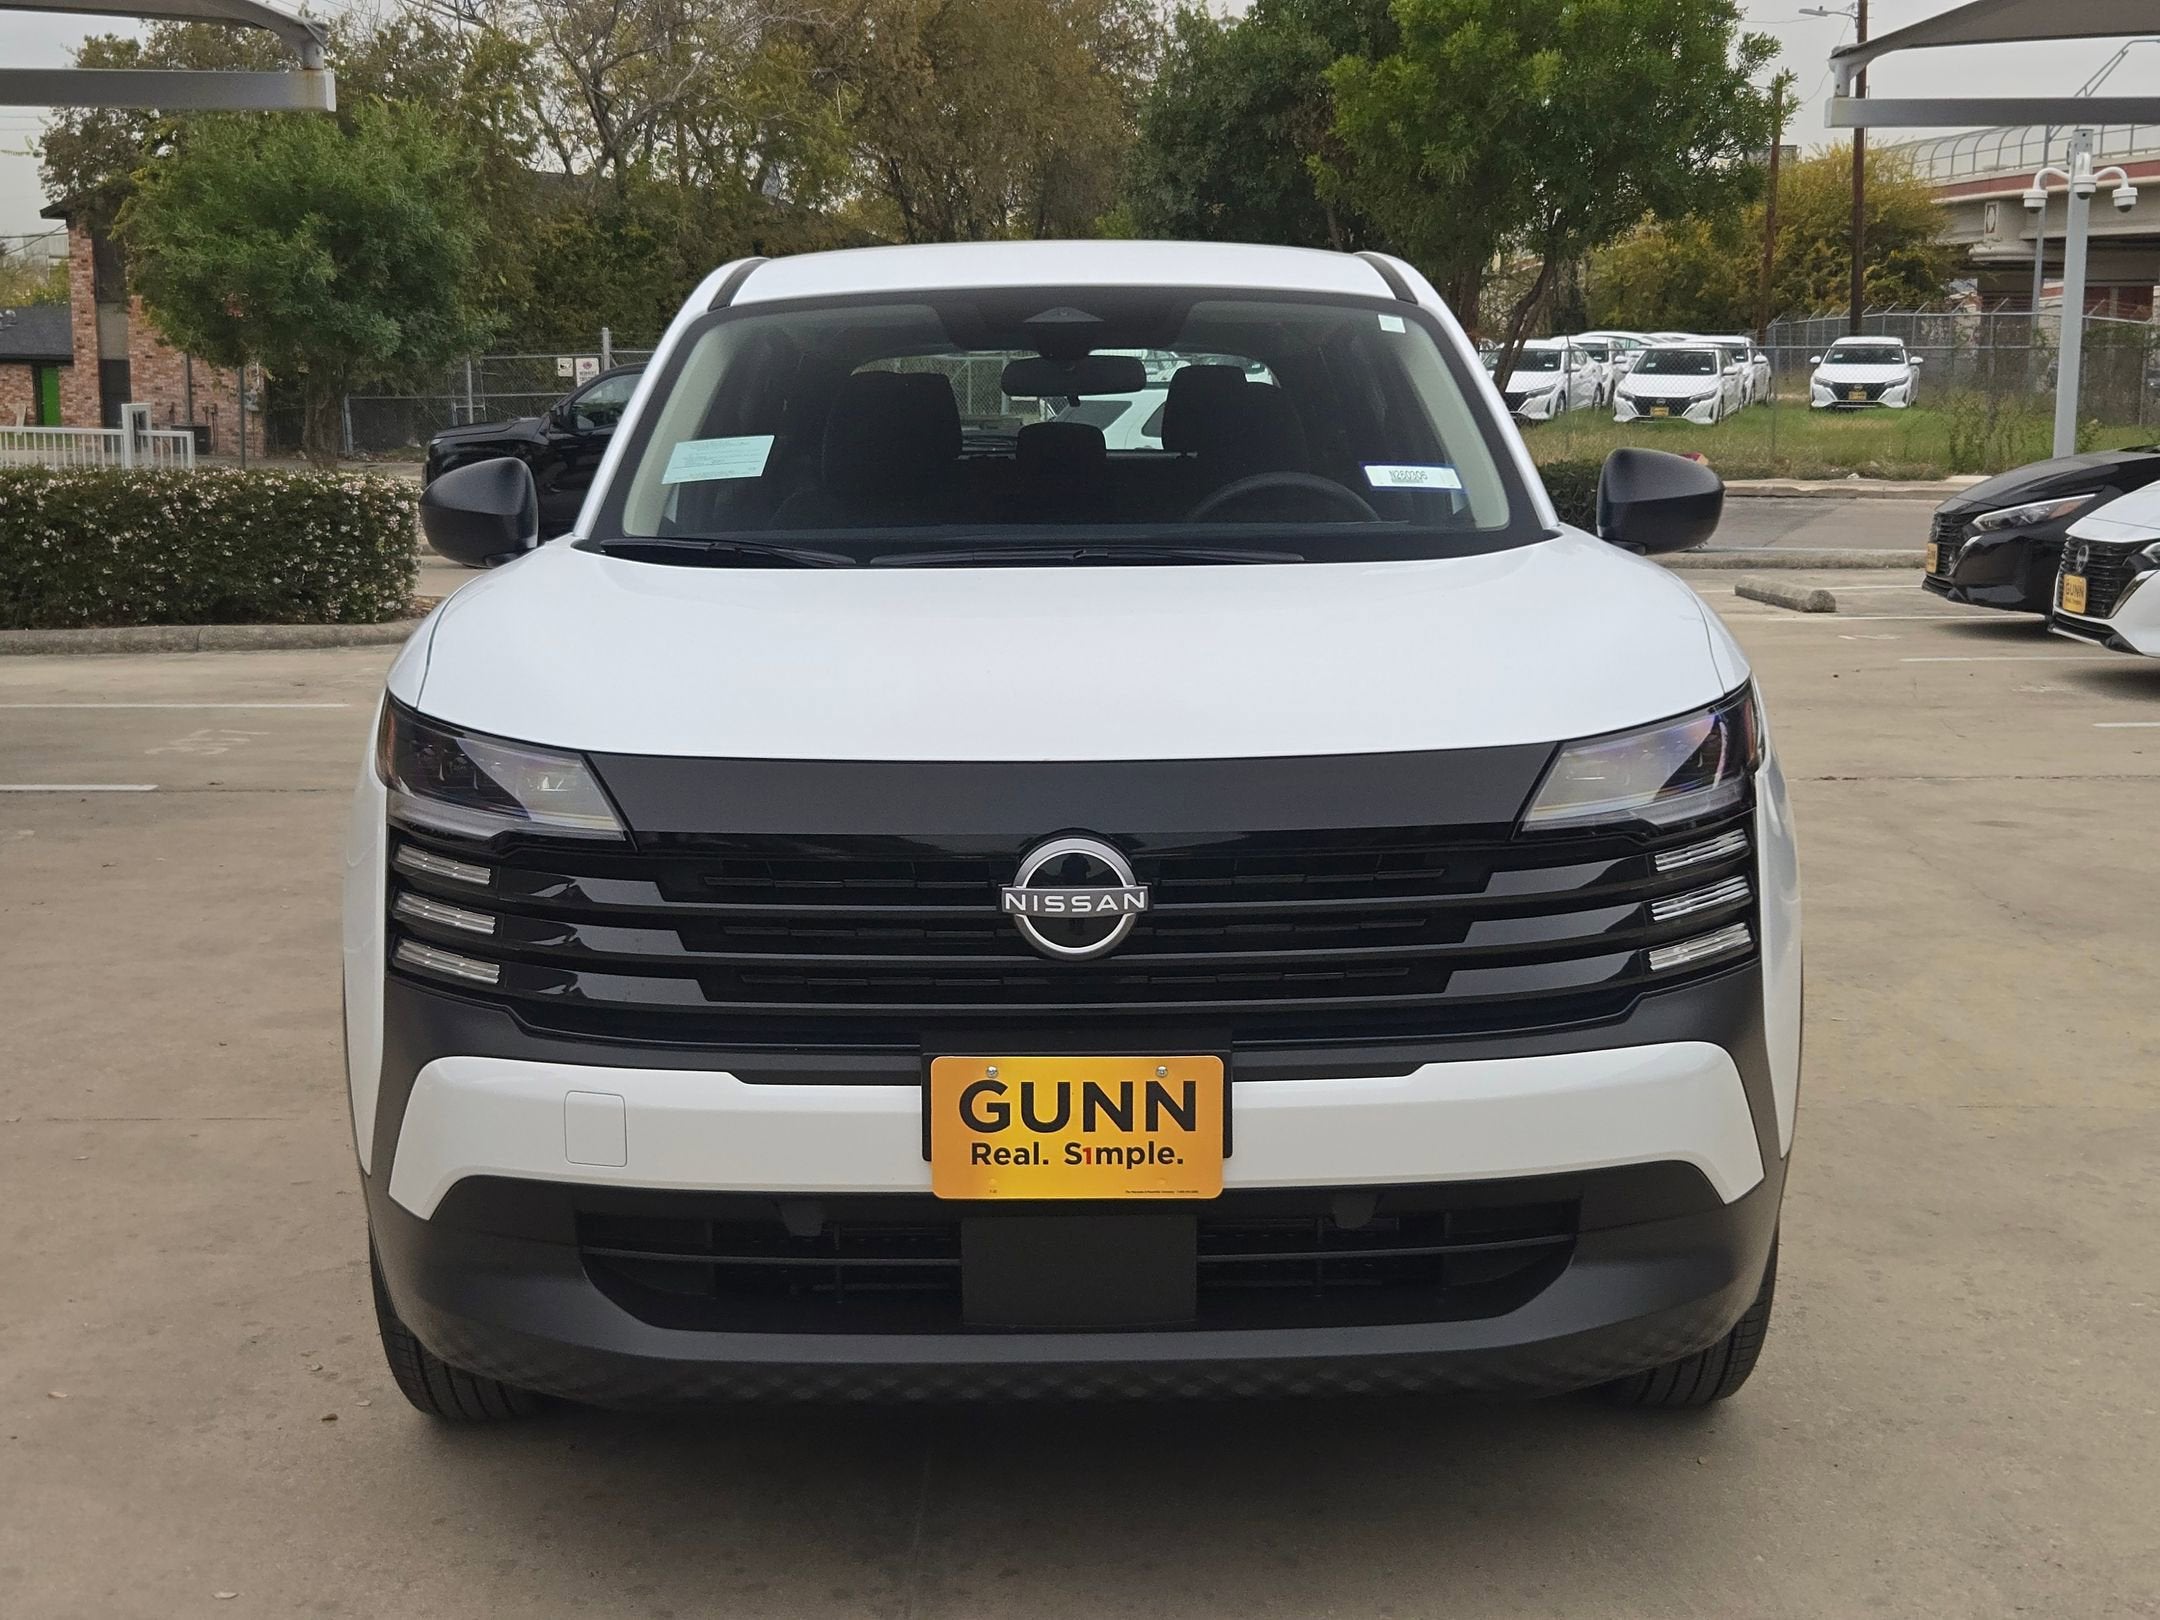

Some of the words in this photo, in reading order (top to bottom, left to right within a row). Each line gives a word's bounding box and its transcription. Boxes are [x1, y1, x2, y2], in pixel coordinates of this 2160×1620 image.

[1005, 891, 1145, 912] NISSAN
[958, 1079, 1197, 1134] GUNN
[971, 1141, 1049, 1166] Real.
